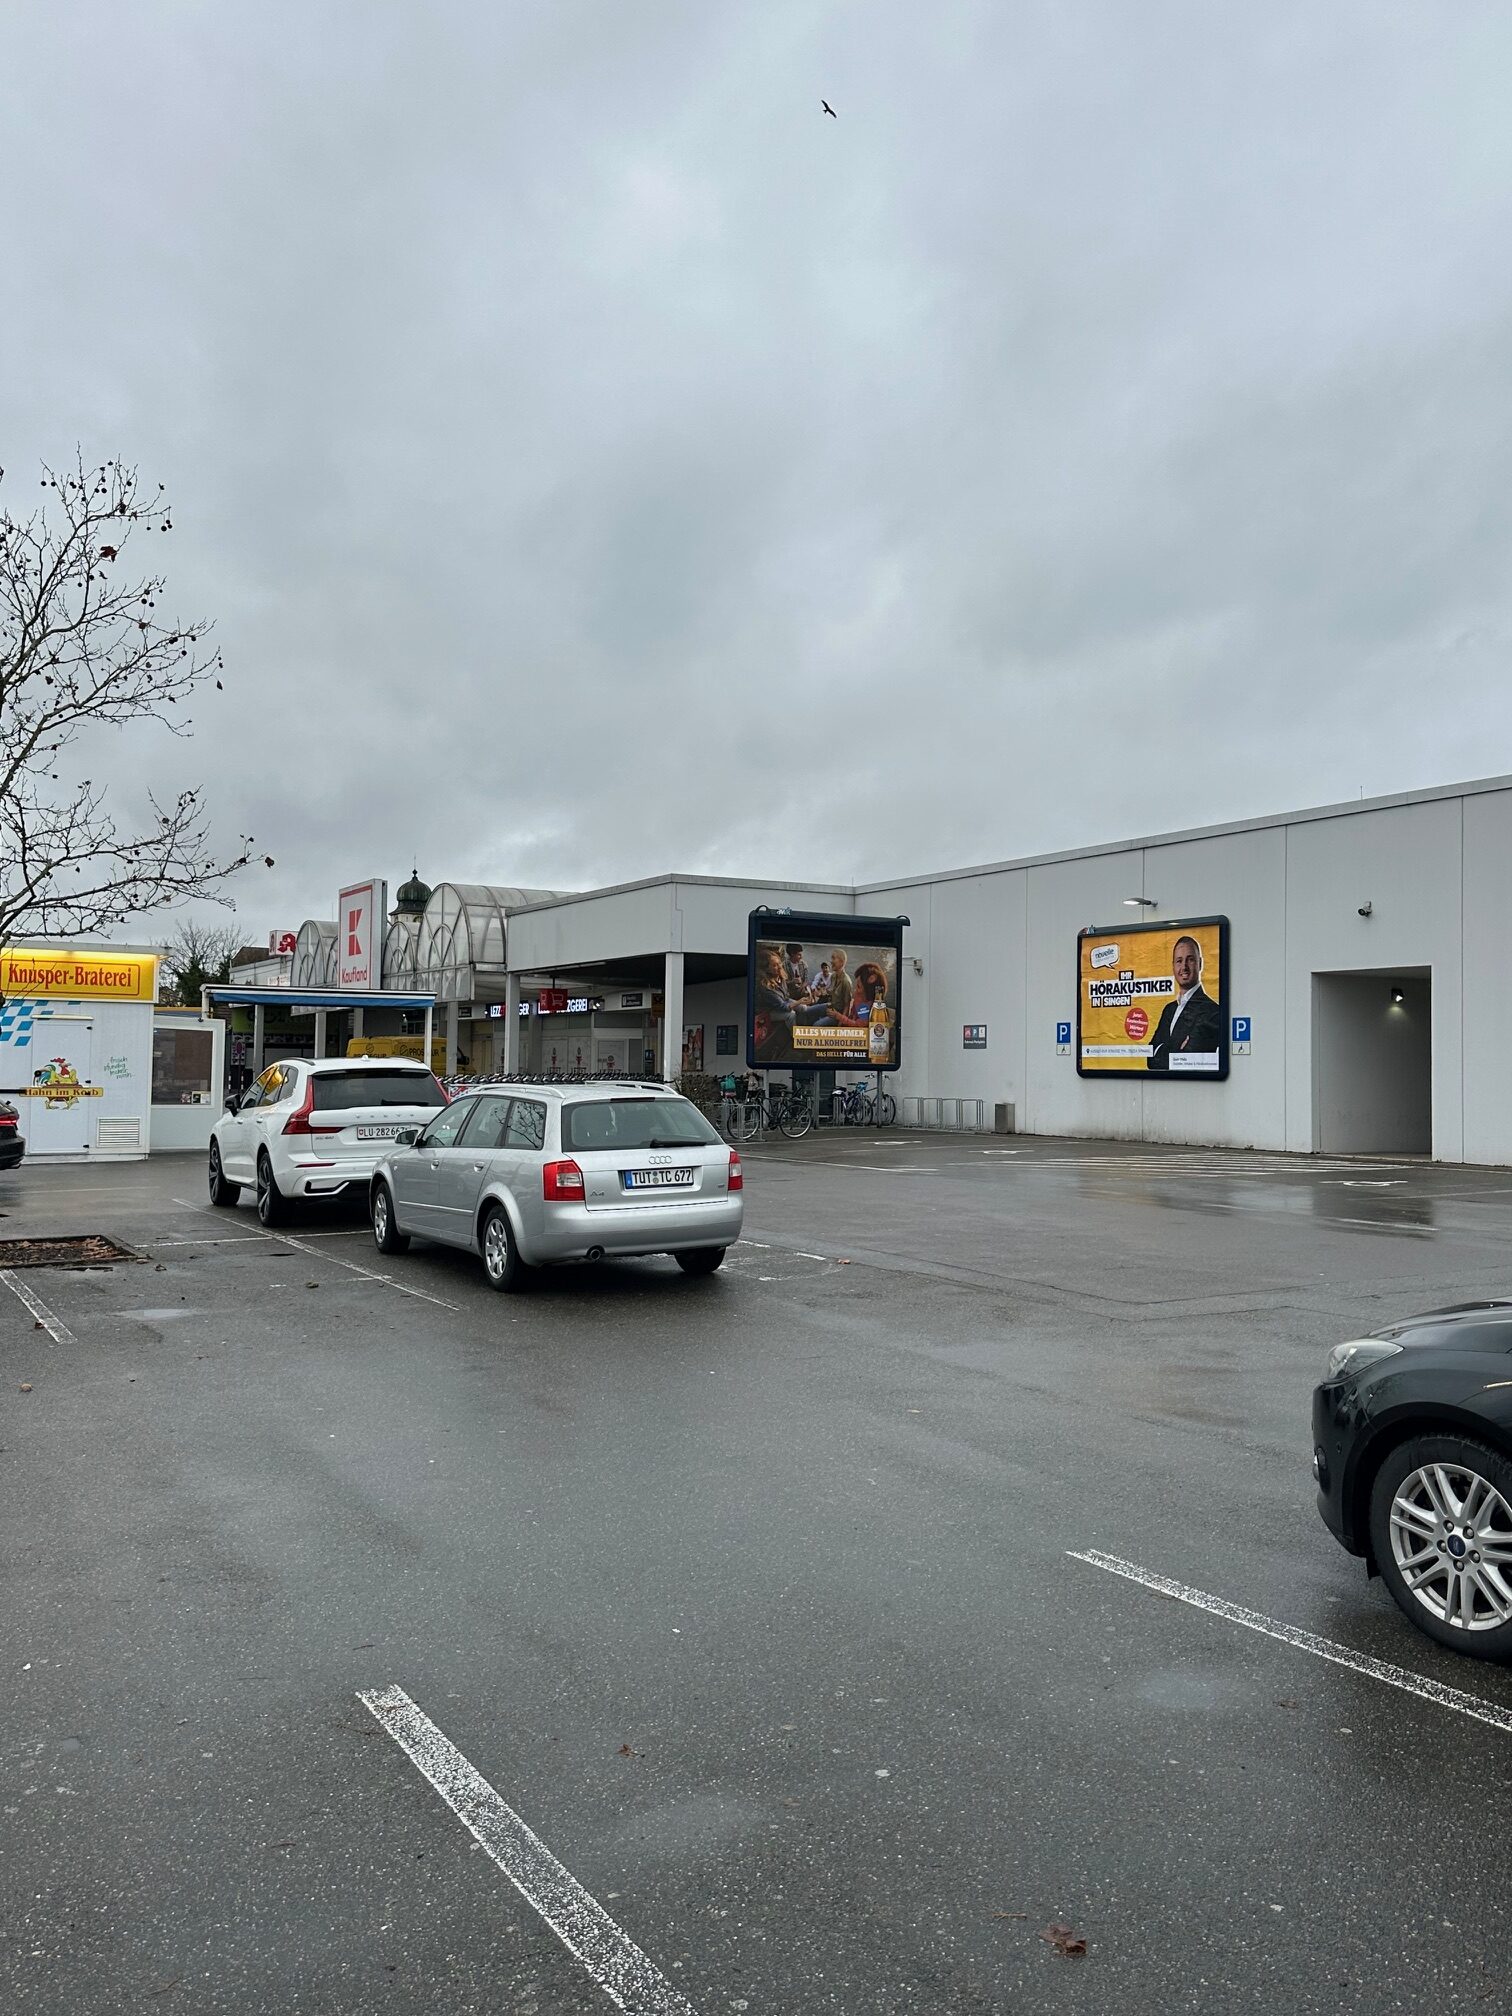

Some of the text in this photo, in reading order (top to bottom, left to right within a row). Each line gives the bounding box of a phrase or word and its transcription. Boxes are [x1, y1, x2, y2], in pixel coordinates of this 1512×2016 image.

[8, 963, 132, 989] Knusper-Braterei
[342, 966, 368, 984] Kaufland
[1121, 971, 1132, 980] IHR
[1090, 980, 1173, 996] HÖRAKUSTIKER
[1092, 996, 1131, 1007] IN SINGEN
[490, 1004, 505, 1017] LEZZ
[795, 1028, 819, 1036] ALLES
[820, 1029, 835, 1037] WIE
[1059, 1024, 1068, 1041] P
[1236, 1020, 1246, 1039] P
[796, 1038, 813, 1046] NUR
[814, 1039, 867, 1047] ALKOHOLFREI
[408, 1047, 440, 1057] PROSUR
[56, 1088, 70, 1096] im
[632, 1169, 692, 1184] TUT TC 677
